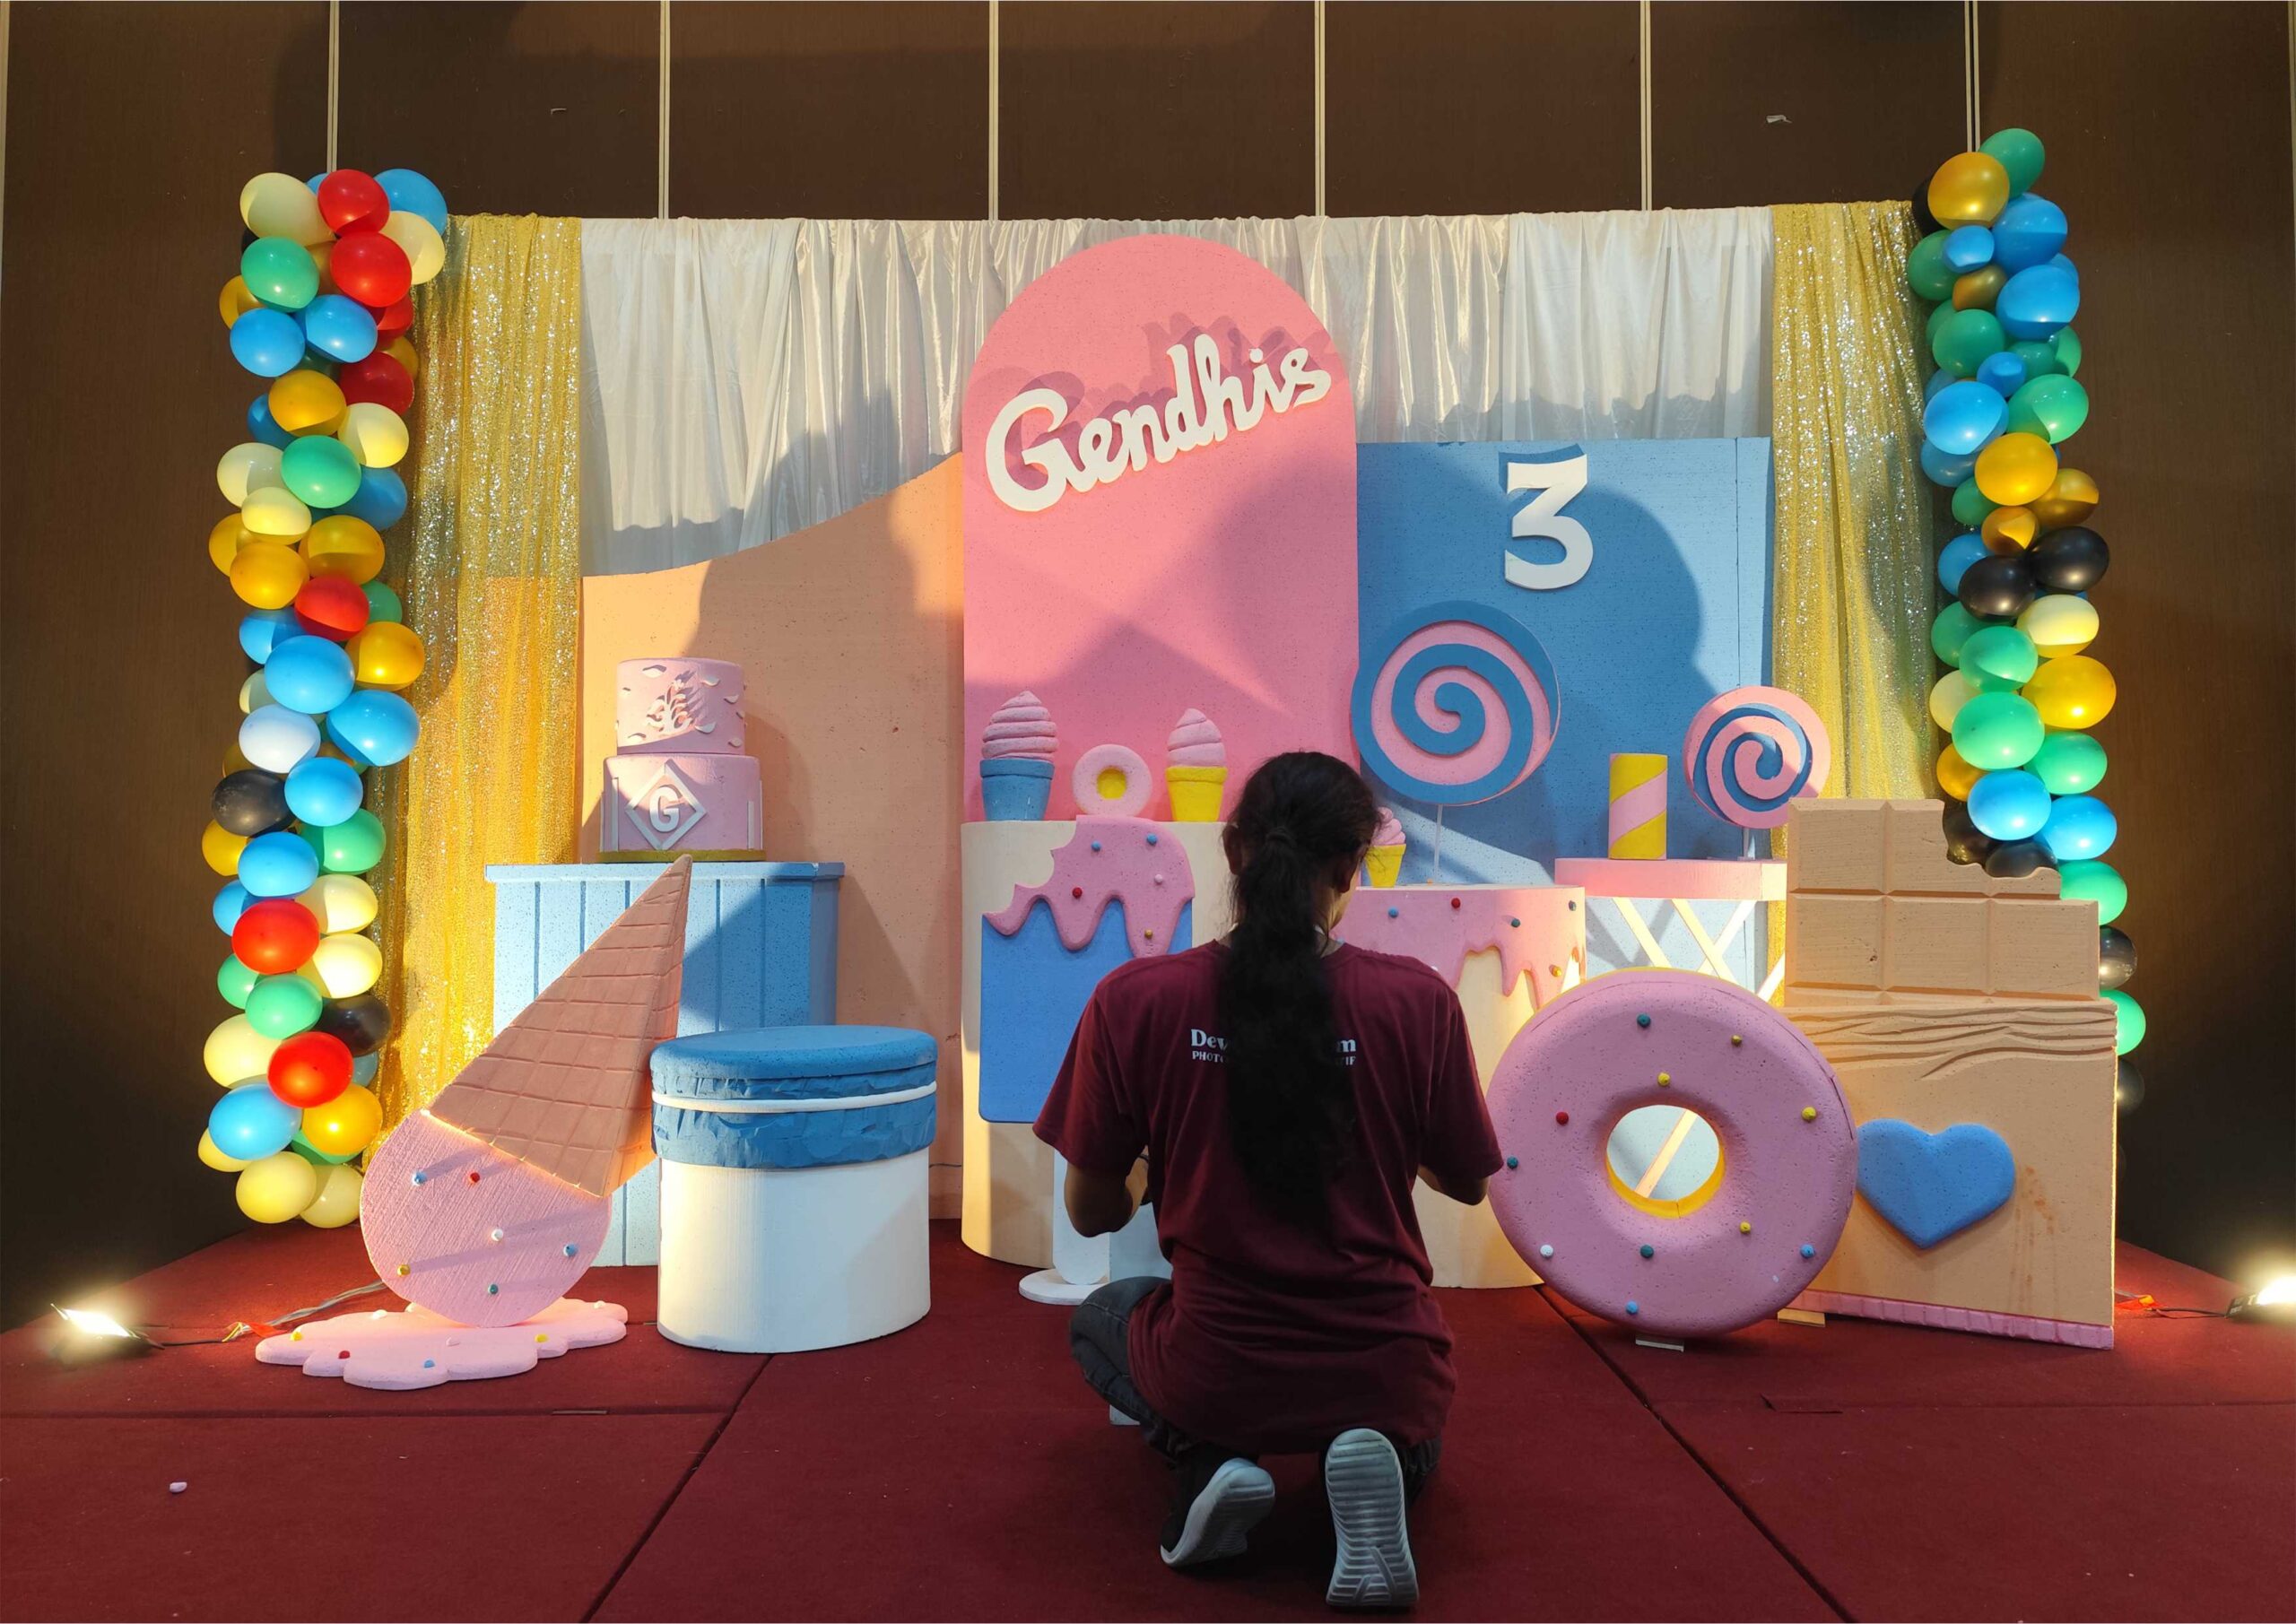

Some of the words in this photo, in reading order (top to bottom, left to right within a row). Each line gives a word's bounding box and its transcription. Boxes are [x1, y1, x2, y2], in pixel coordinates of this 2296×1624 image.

[986, 334, 1331, 512] Gendhis
[1504, 453, 1594, 590] 3
[649, 786, 681, 833] G
